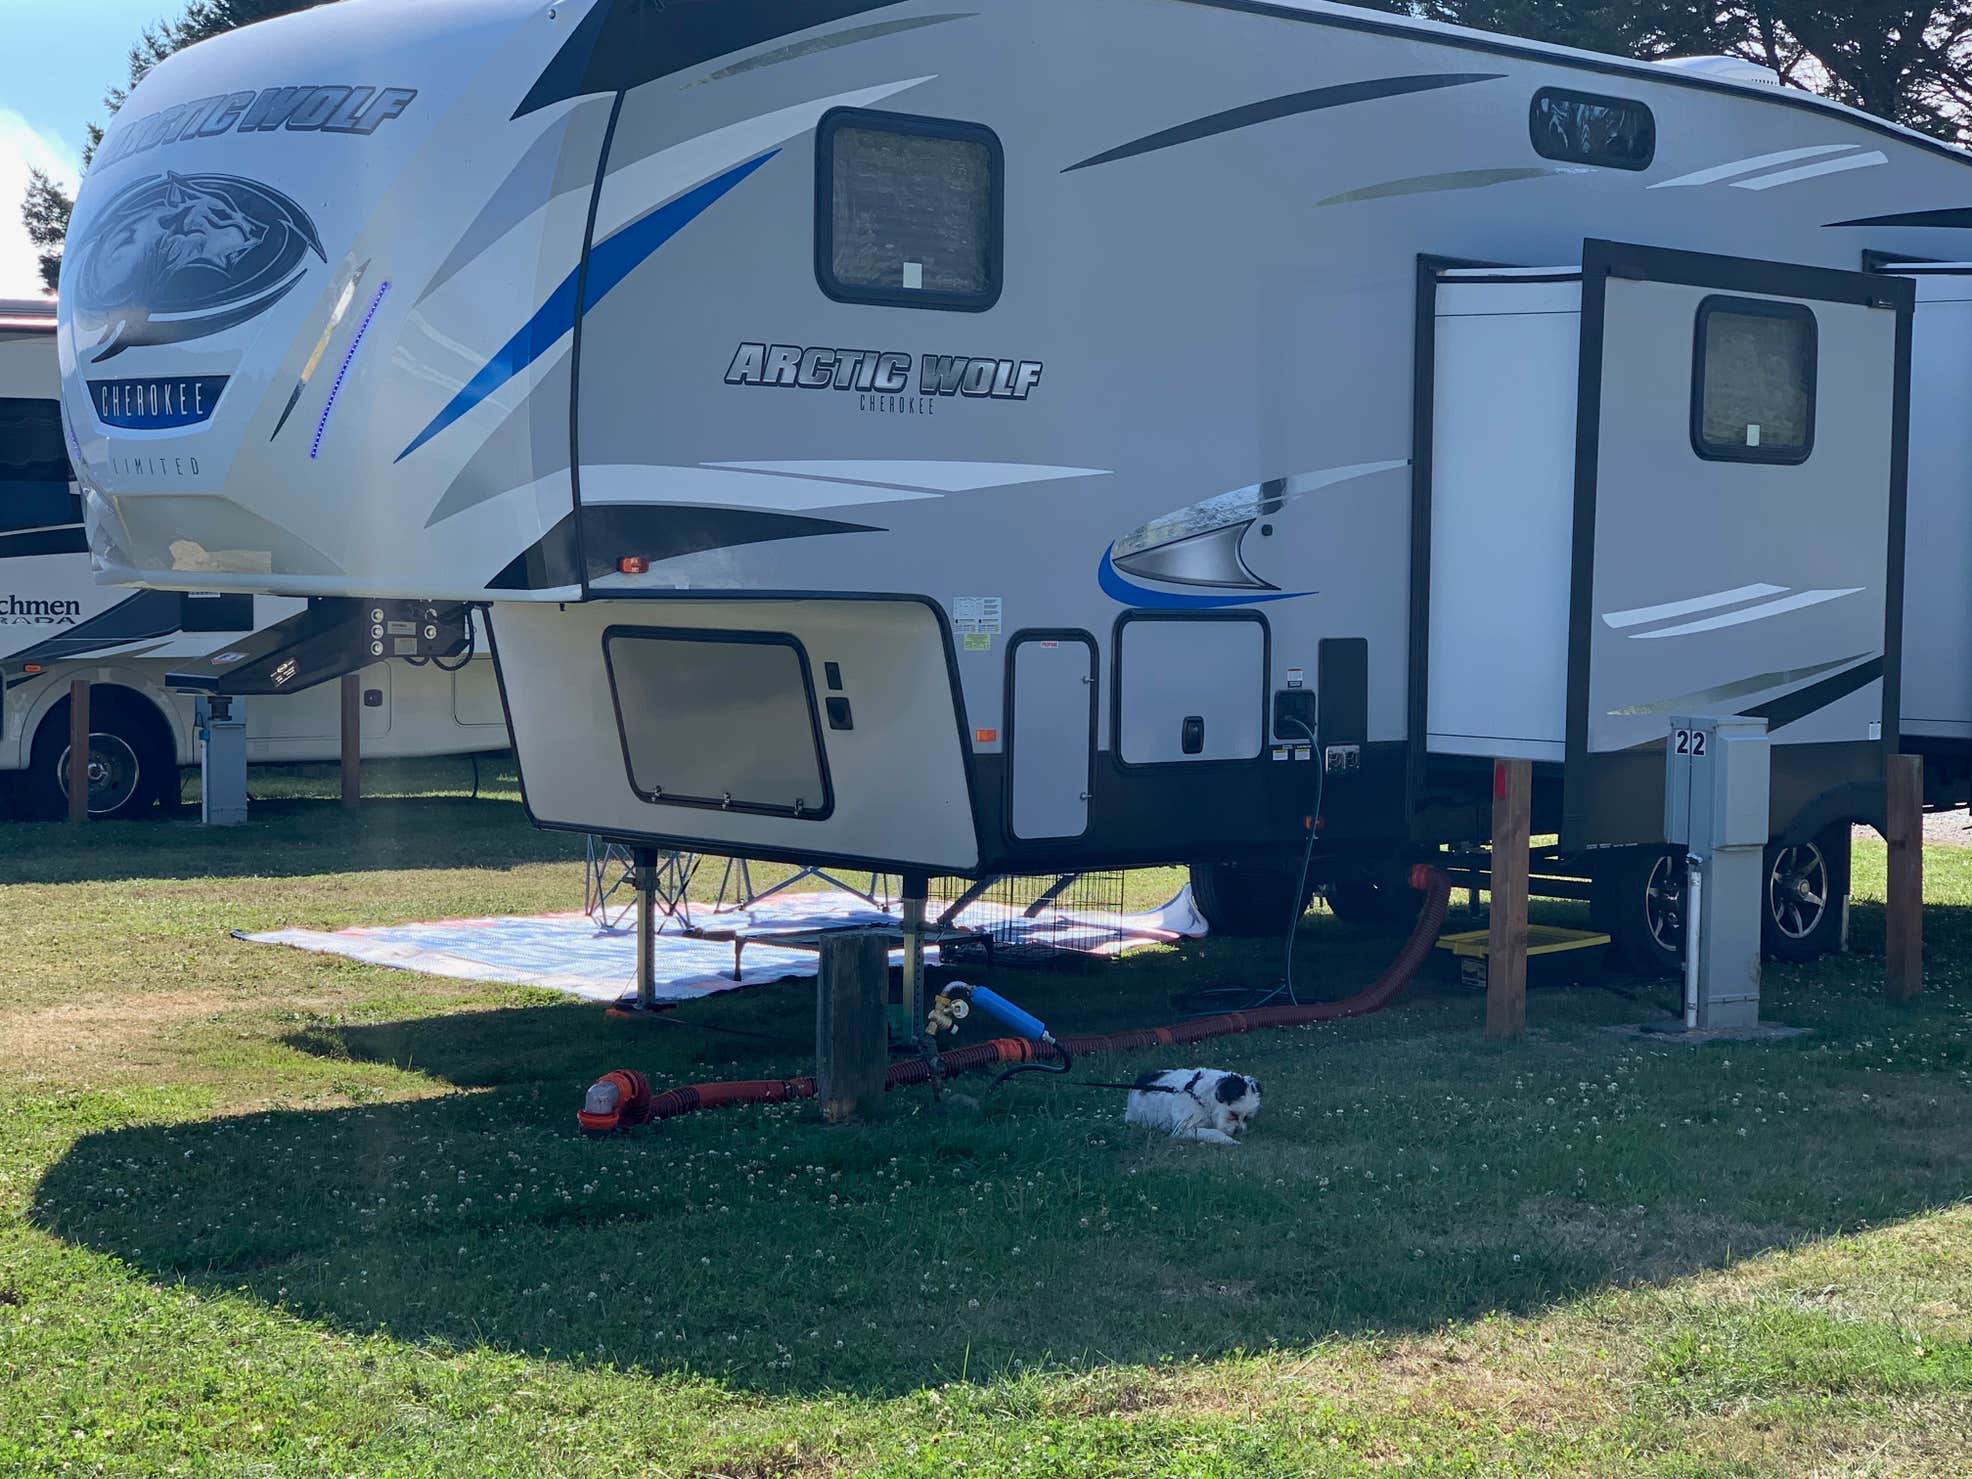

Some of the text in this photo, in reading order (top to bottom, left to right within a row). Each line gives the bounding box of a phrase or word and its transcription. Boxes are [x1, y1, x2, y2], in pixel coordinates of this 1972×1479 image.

[237, 86, 418, 135] WOLF
[724, 342, 1043, 400] ARCTIC WOLF
[102, 383, 204, 416] CHEROKEE
[860, 394, 935, 415] CHEROKEE
[112, 457, 200, 476] LIMITED
[1676, 730, 1705, 756] 22
